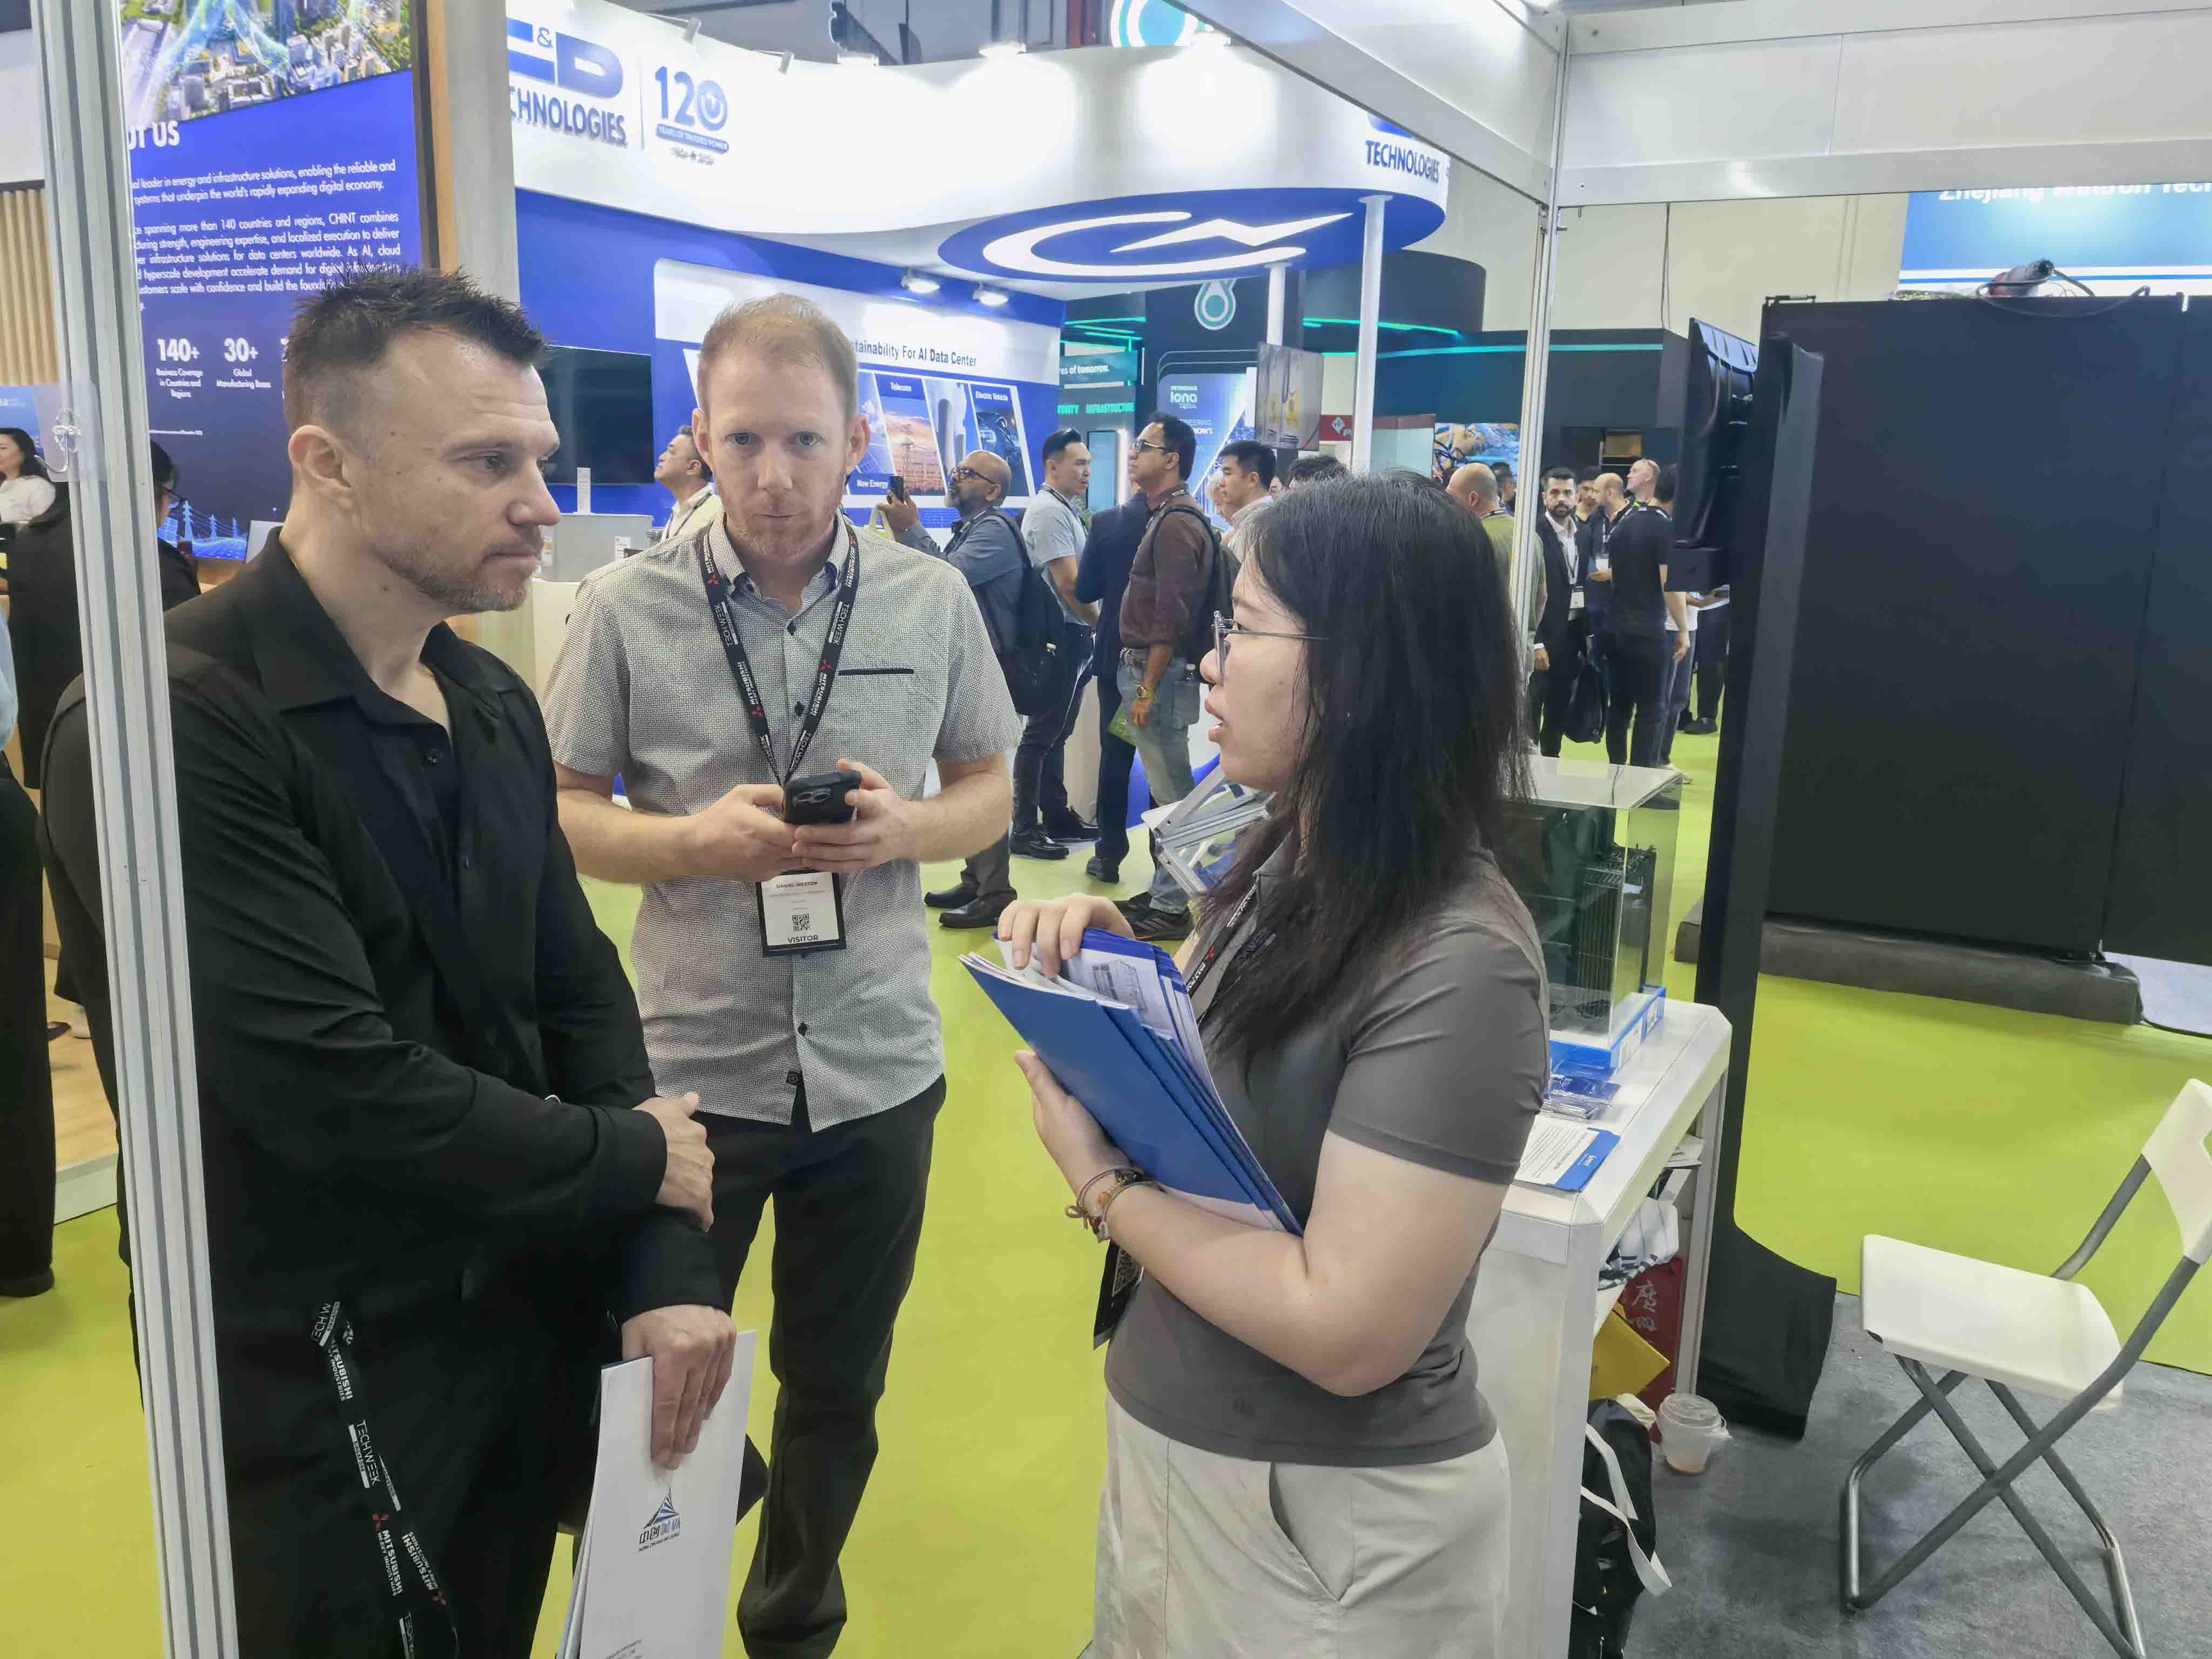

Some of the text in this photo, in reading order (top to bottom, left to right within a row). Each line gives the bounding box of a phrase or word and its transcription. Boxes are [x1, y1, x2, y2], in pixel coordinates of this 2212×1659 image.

[153, 121, 179, 147] US
[197, 173, 212, 184] and
[213, 171, 260, 184] infrastructure
[298, 164, 332, 177] enabling
[334, 163, 346, 175] the
[348, 160, 377, 173] reliable
[379, 158, 396, 172] and
[1365, 140, 1439, 183] TECHNOLOGIES
[161, 191, 175, 203] that
[176, 189, 208, 203] underpin
[210, 188, 221, 199] the
[222, 186, 248, 198] world's
[250, 184, 275, 199] rapidly
[277, 181, 318, 197] expanding
[319, 179, 344, 194] digital
[345, 180, 385, 192] economy.
[144, 223, 176, 235] spanning
[179, 224, 199, 232] more
[200, 220, 217, 231] than
[221, 219, 236, 230] 140
[239, 217, 273, 229] countries
[275, 215, 291, 227] and
[294, 215, 325, 228] regions,
[328, 212, 356, 225] CHINT
[360, 211, 399, 224] combines
[190, 235, 233, 248] engineering
[271, 232, 286, 244] and
[288, 230, 322, 242] localized
[323, 229, 360, 241] execution
[362, 230, 370, 240] to
[372, 227, 400, 239] deliver
[199, 251, 230, 262] solutions
[233, 249, 245, 261] for
[248, 249, 266, 260] data
[270, 248, 298, 259] centers
[348, 246, 358, 257] As
[377, 243, 401, 255] cloud
[183, 266, 228, 279] development
[231, 265, 269, 276] accelerate
[271, 262, 302, 275] demand
[305, 262, 316, 274] for
[207, 281, 246, 293] confidence
[247, 280, 262, 292] and
[265, 278, 284, 292] build
[285, 278, 298, 291] the
[157, 338, 200, 362] 140+
[224, 337, 259, 362] 30+
[851, 340, 977, 367] tainability For AI Data Center
[788, 934, 819, 943] VISITOR
[356, 1419, 373, 1451] TECH
[364, 1449, 381, 1486] WEEK
[382, 1529, 403, 1594] MITSUBISHI
[402, 1534, 434, 1590] MITSUBISHI
